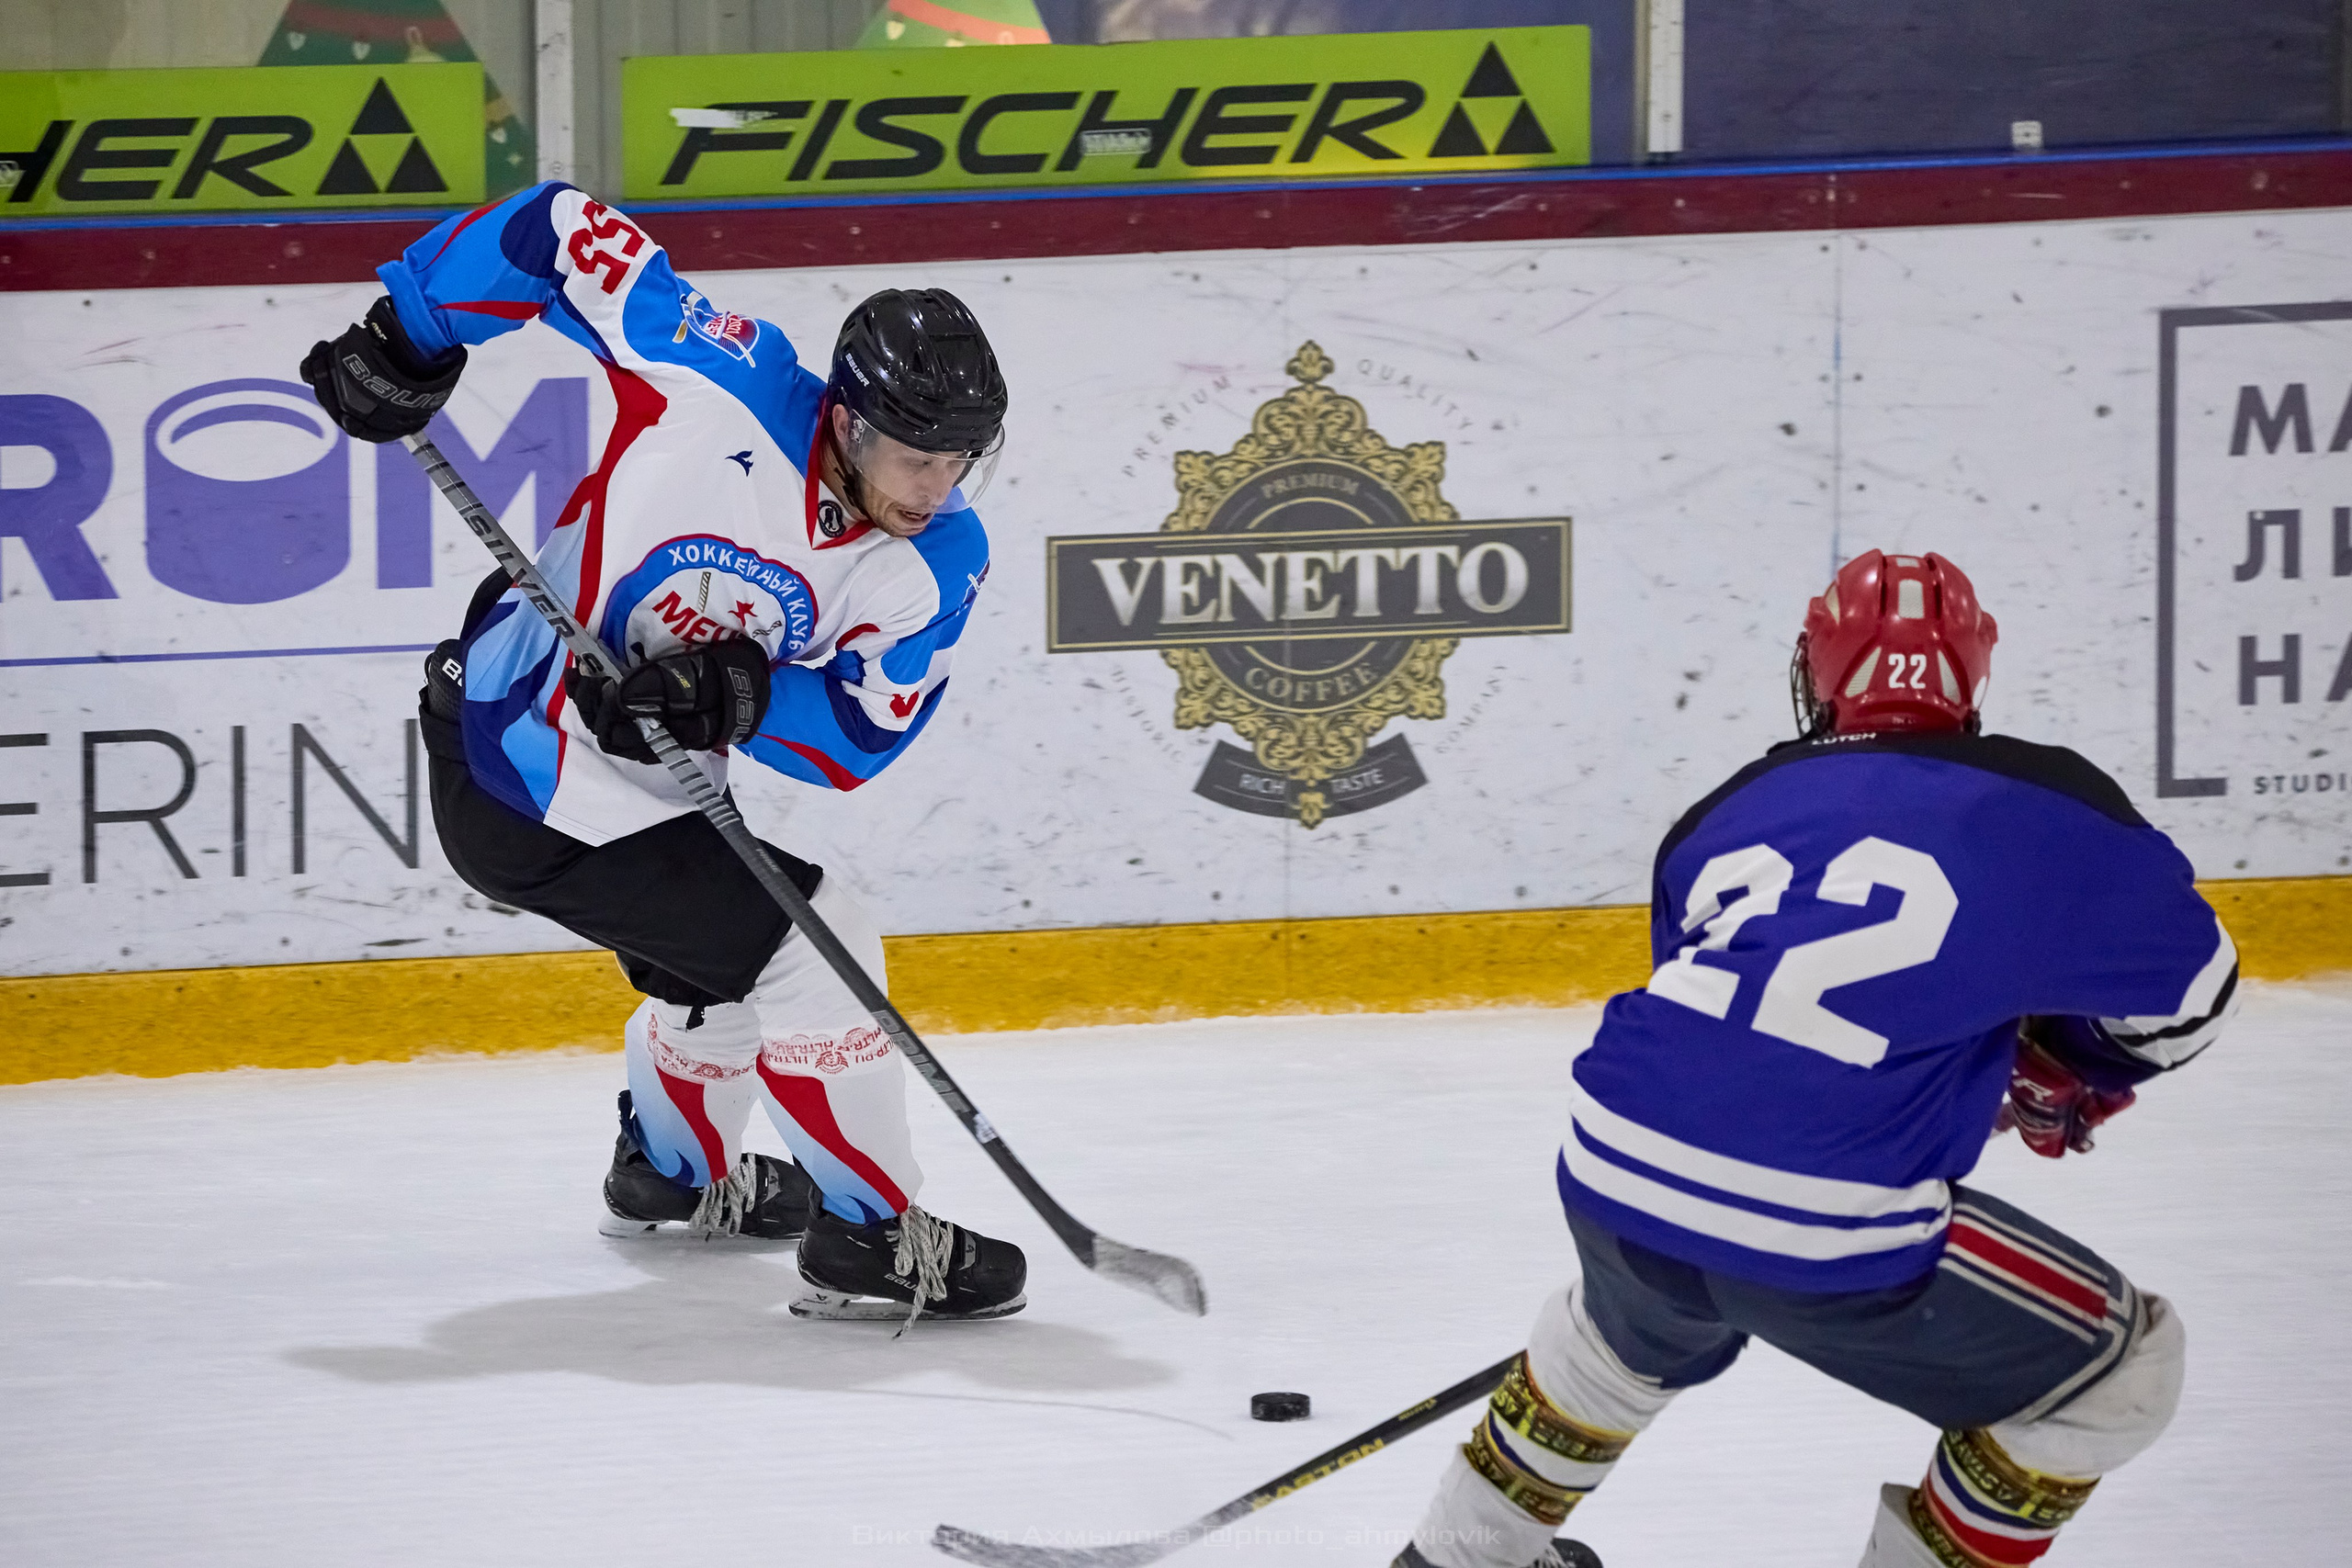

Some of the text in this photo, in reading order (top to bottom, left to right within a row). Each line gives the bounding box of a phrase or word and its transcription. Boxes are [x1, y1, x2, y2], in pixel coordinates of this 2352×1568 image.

[660, 79, 1427, 186] FISCHER
[844, 353, 870, 388] BAUER
[1357, 358, 1472, 430] QUALITY
[1261, 472, 1361, 499] PREMIUM
[463, 513, 576, 638] SILVER
[667, 543, 807, 651] ХОККЕЙНЫЙ КЛУБ
[1091, 540, 1530, 627] VENETTO
[1244, 660, 1381, 705] COFFEE
[1887, 653, 1928, 689] 22
[1238, 773, 1287, 795] RICH
[1329, 767, 1385, 794] TASTE
[2254, 772, 2352, 795] STUDI
[1645, 835, 1960, 1069] 22
